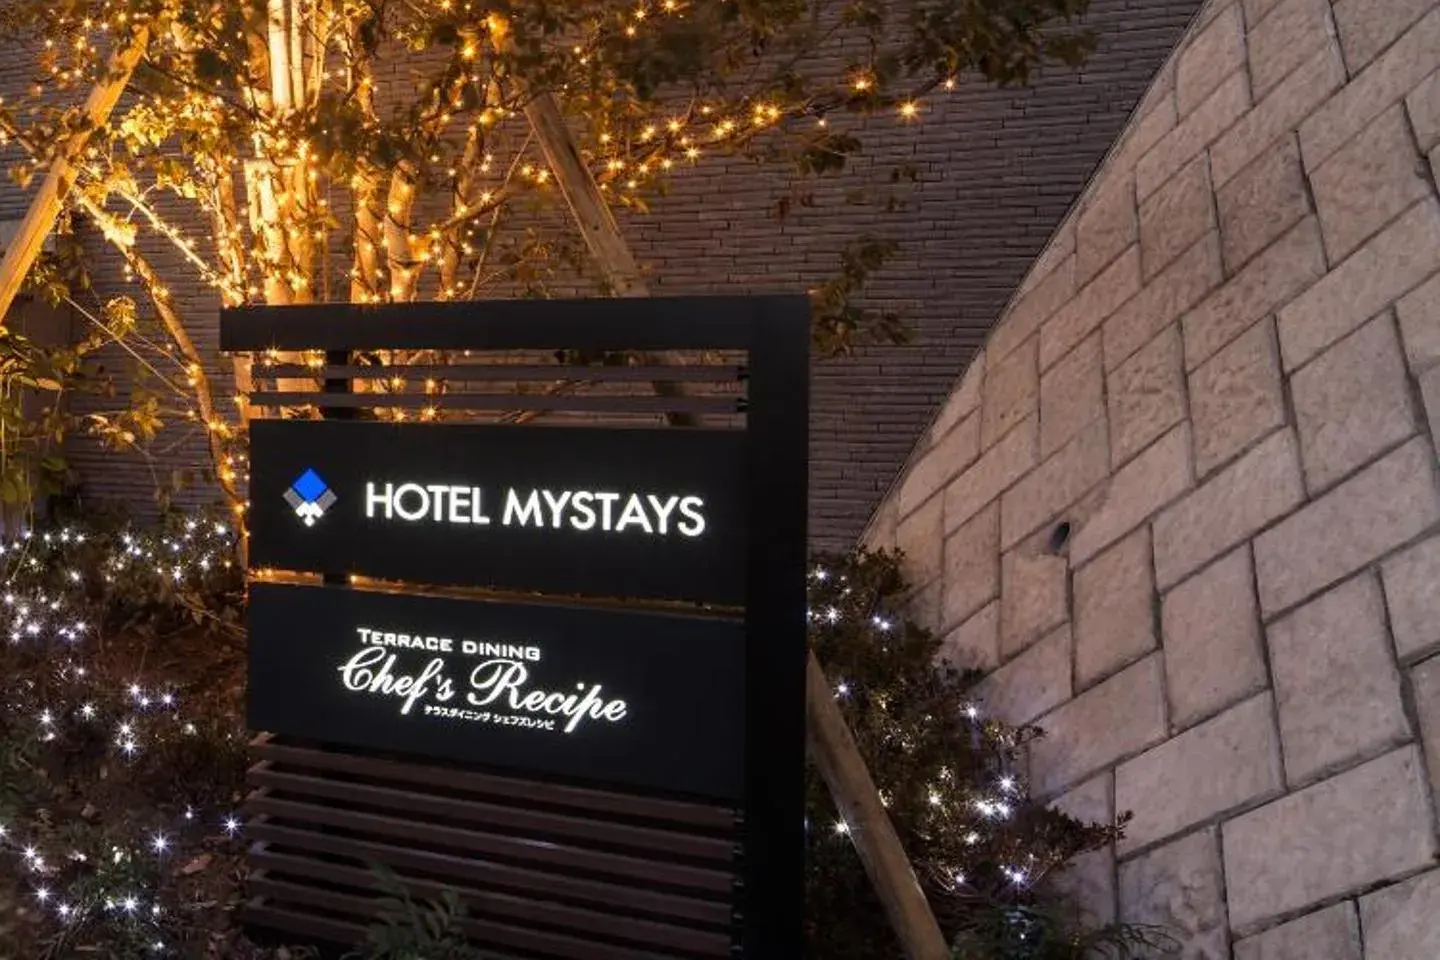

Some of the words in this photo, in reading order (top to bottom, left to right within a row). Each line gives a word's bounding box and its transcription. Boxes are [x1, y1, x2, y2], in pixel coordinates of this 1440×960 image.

[366, 481, 491, 525] HOTEL
[502, 487, 706, 537] MYSTAYS
[356, 627, 453, 652] TERRACE
[462, 639, 541, 662] DINING
[337, 646, 456, 715] Chef's
[467, 658, 628, 734] Recipe
[423, 704, 491, 723] テラスダイニング
[492, 713, 556, 731] シェフズレシピ
